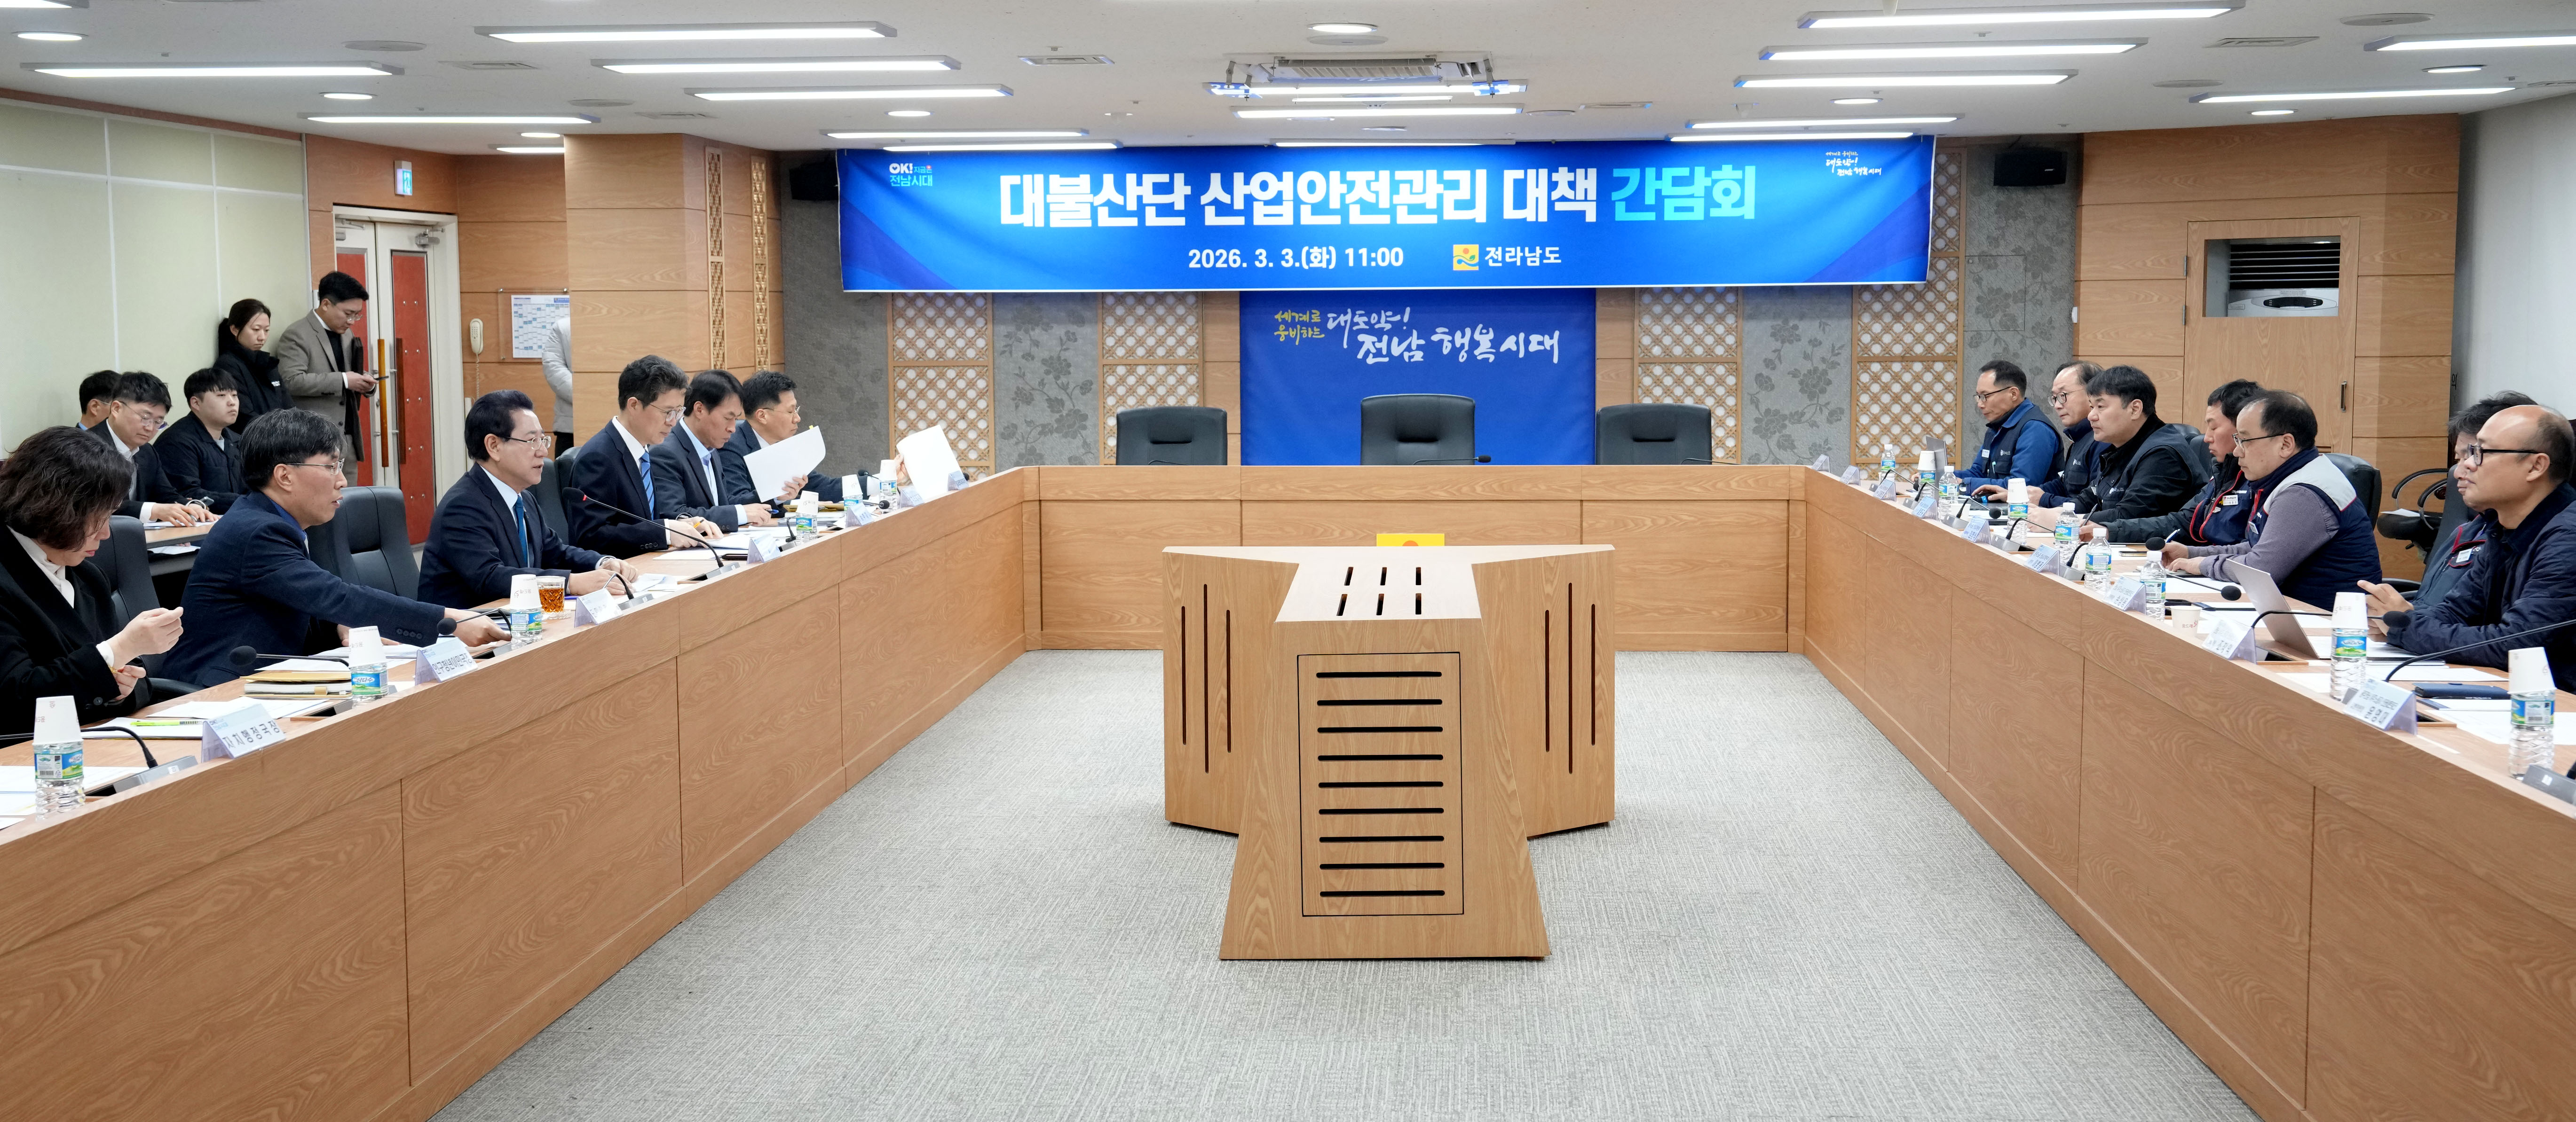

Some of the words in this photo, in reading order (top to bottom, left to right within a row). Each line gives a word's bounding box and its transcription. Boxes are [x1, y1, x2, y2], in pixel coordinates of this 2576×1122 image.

[890, 163, 913, 173] OK!
[890, 175, 933, 187] 전남시대
[1000, 173, 1191, 227] 대불산단
[1201, 170, 1486, 226] 산업안전관리
[1503, 167, 1596, 222] 대책
[1612, 165, 1755, 221] 간담회
[1189, 249, 1247, 268] 2026.
[1255, 248, 1273, 267] 3.
[1281, 246, 1336, 269] 3.(화)
[1345, 247, 1403, 267] 11:00
[1485, 247, 1562, 267] 전라남도
[1274, 310, 1321, 322] 세계로
[1274, 324, 1325, 345] 웅비하는
[1328, 307, 1411, 348] 대도약!
[1358, 330, 1425, 364] 전남
[222, 720, 280, 748] 자치행정국장
